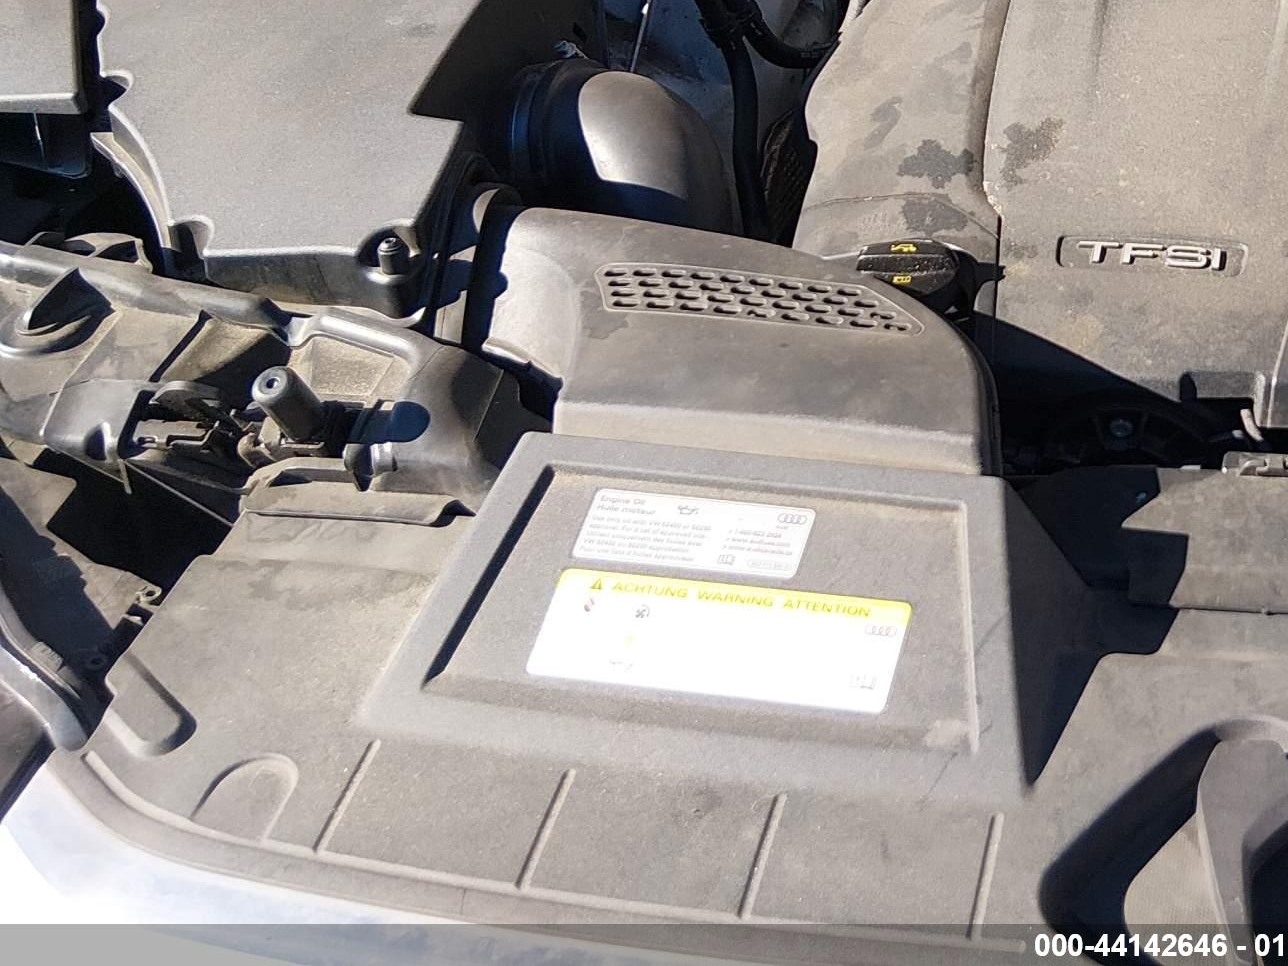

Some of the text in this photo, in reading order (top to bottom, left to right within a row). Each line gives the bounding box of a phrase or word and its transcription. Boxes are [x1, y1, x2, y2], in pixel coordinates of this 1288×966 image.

[1077, 240, 1227, 271] TFSI
[600, 494, 630, 505] Engine
[611, 583, 871, 617] ACHTUNG WARNING ATTENTION
